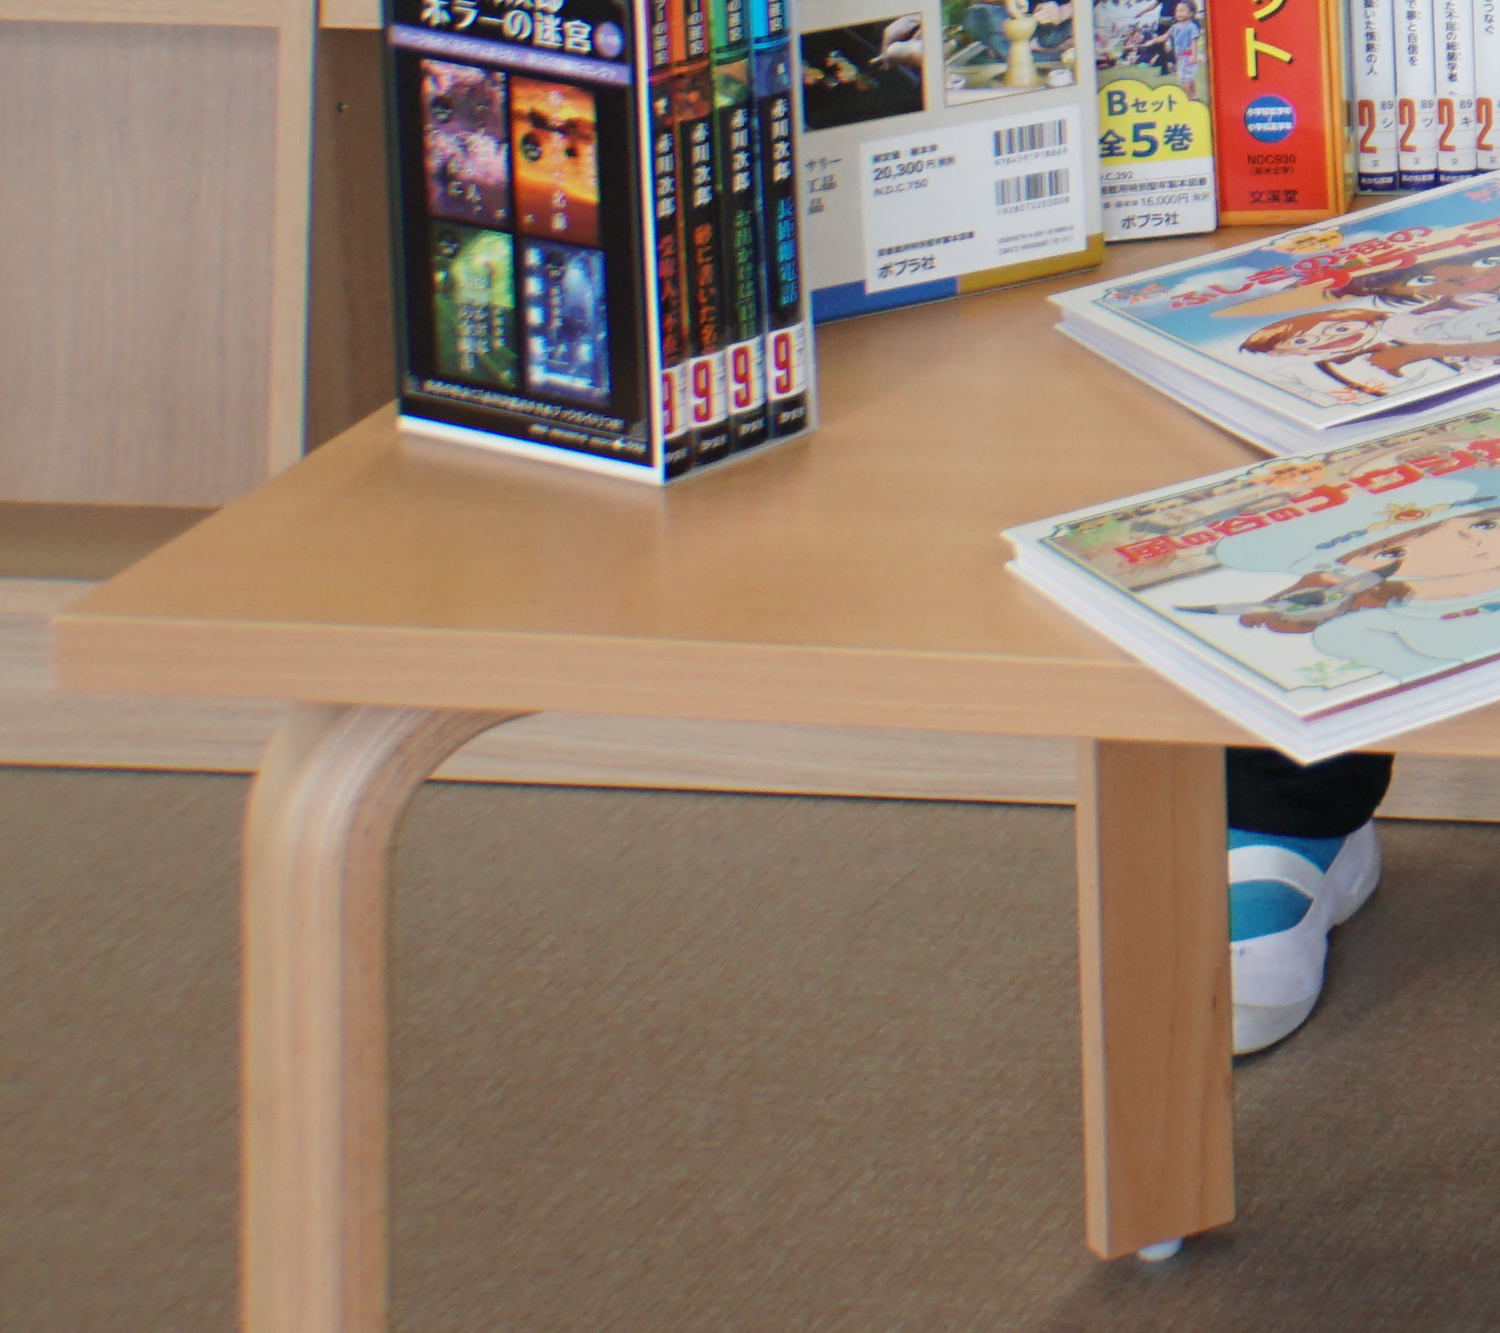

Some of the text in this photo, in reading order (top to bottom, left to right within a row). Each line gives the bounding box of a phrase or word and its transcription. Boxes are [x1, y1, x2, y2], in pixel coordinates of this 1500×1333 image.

[1106, 89, 1178, 117] Bセット
[1358, 99, 1378, 154] 2
[1399, 98, 1417, 152] 2
[1438, 98, 1456, 152] 2
[1098, 121, 1195, 158] 全5巻
[1121, 211, 1181, 230] ポプラ社
[876, 255, 937, 280] ポプラ社
[732, 344, 753, 409] 9
[773, 331, 793, 396] 9
[693, 359, 714, 424] 9
